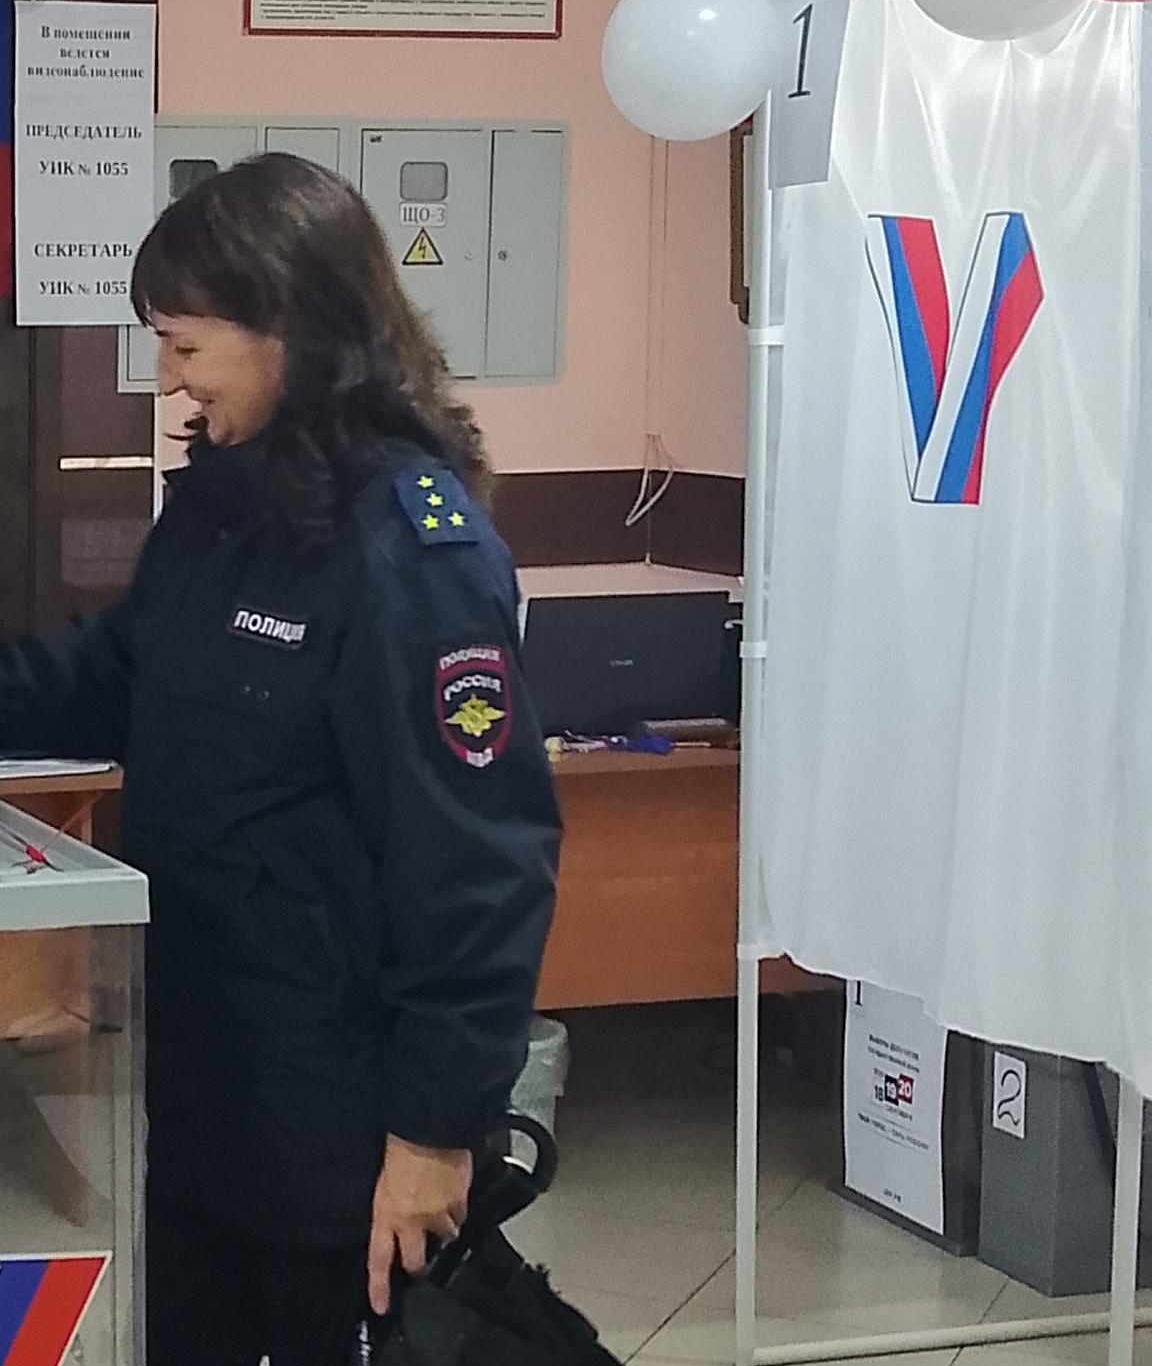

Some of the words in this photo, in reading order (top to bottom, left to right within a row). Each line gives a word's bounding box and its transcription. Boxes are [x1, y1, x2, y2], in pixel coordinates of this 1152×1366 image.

[41, 25, 50, 38] В
[53, 28, 131, 41] помещении
[787, 3, 814, 99] 1
[27, 64, 145, 78] видеонаблюдение
[26, 124, 143, 141] ПРЕДСЕДАТЕЛЬ
[39, 160, 74, 175] УИК
[96, 161, 129, 176] 1055
[403, 206, 446, 223] ЩО-3
[34, 243, 133, 258] СЕКРЕТАРЬ
[39, 280, 74, 296] УИК
[94, 281, 127, 296] 1055
[234, 610, 306, 643] ПОЛИЦИЯ
[443, 675, 502, 701] РОССИЯ
[874, 1084, 884, 1102] 18
[886, 1081, 897, 1100] 19
[898, 1078, 912, 1099] 20
